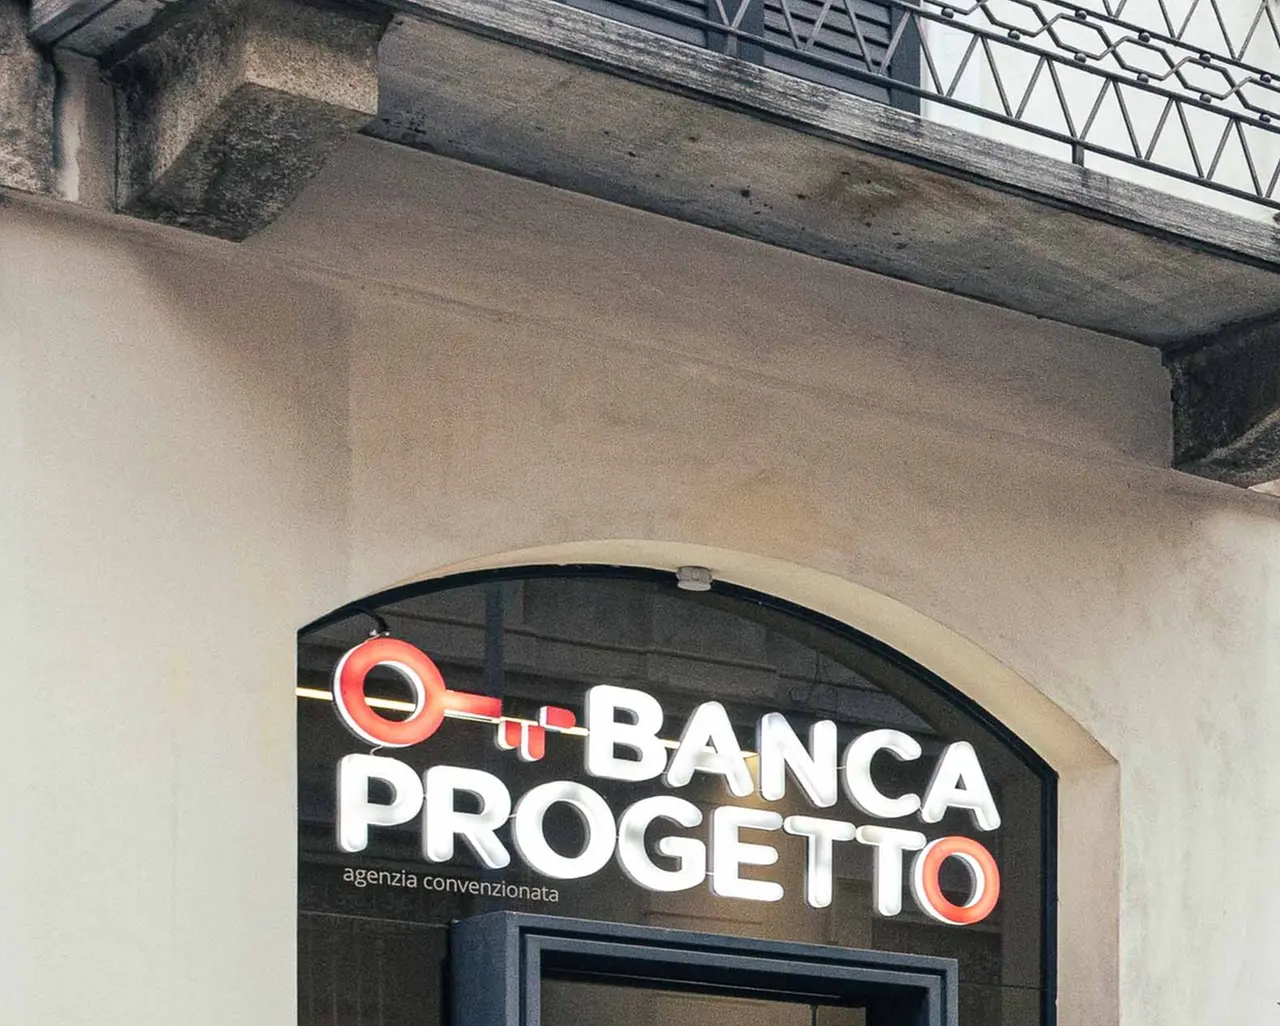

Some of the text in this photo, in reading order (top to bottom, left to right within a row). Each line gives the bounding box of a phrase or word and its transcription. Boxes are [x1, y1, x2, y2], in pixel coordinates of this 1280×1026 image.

[584, 684, 1001, 832] BANCA
[336, 752, 1000, 926] PROGETTO
[343, 867, 559, 902] agenzia convenzionata
